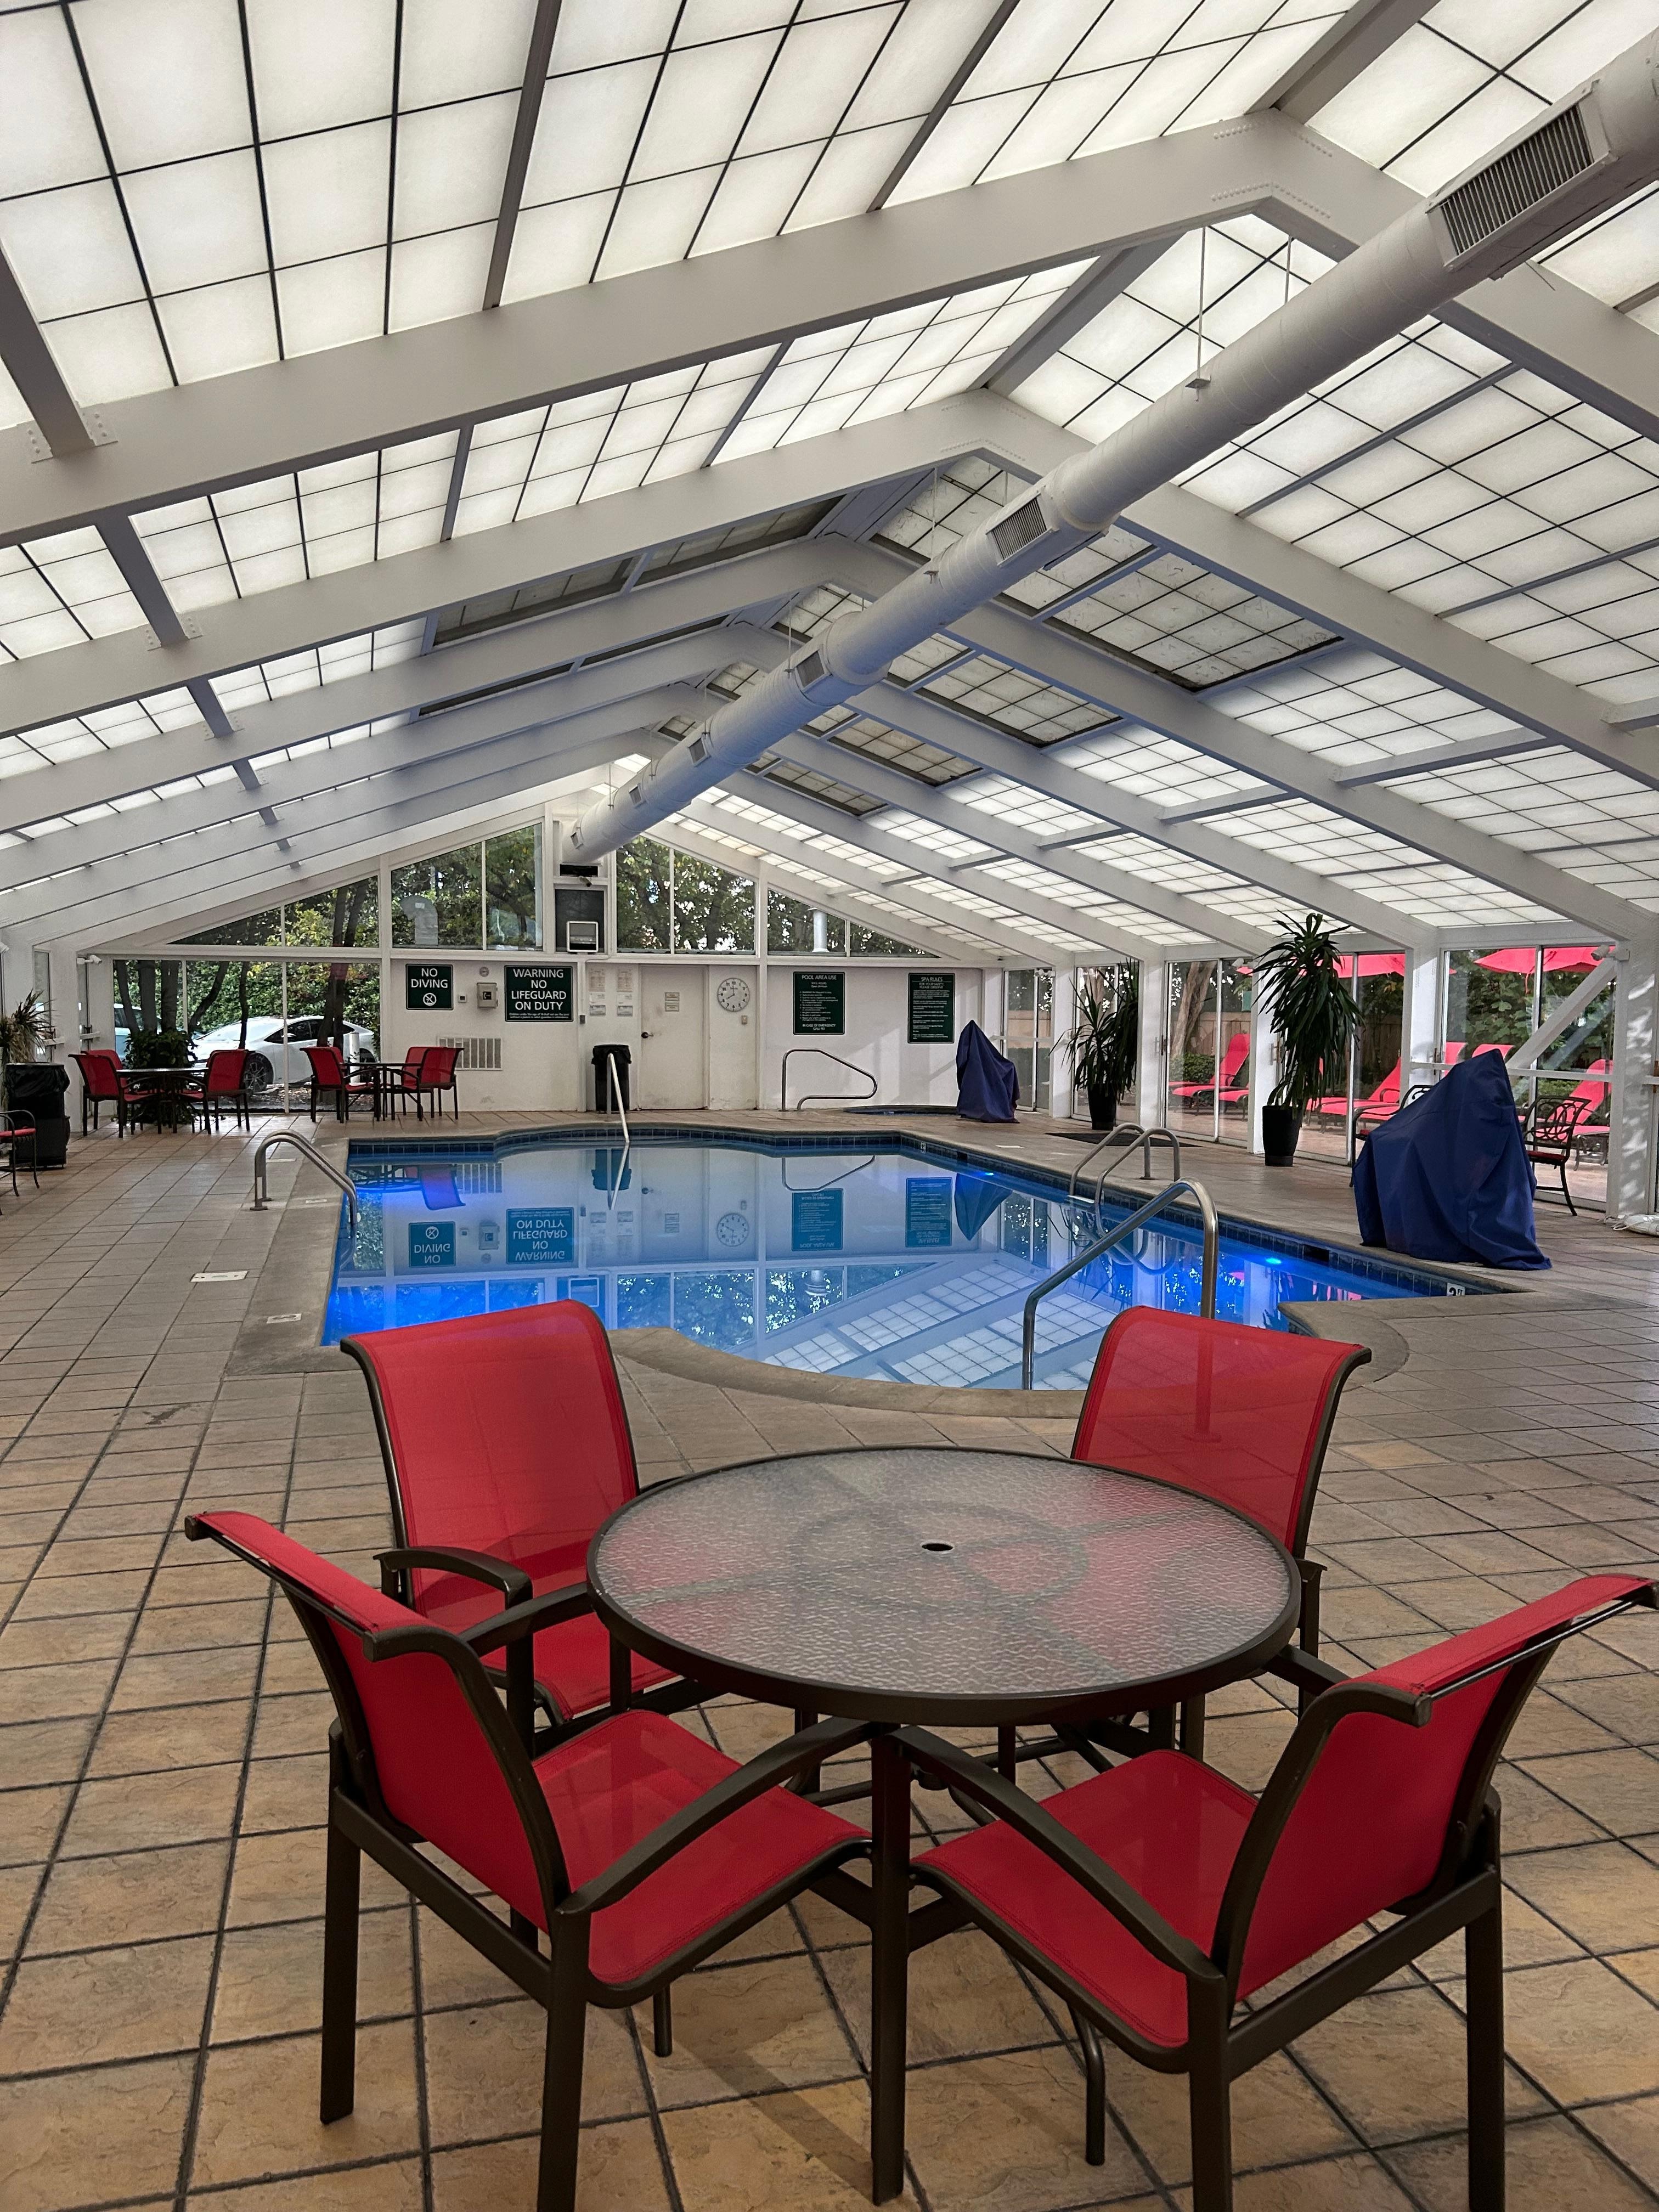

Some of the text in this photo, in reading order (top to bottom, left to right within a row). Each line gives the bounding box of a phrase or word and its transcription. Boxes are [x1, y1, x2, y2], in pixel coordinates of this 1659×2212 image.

[421, 968, 438, 977] NO
[513, 968, 564, 978] WARNING
[411, 979, 448, 989] DIVING
[531, 980, 547, 989] NO
[511, 990, 567, 1000] LIFEGUARD
[515, 1001, 563, 1011] ON DUTY
